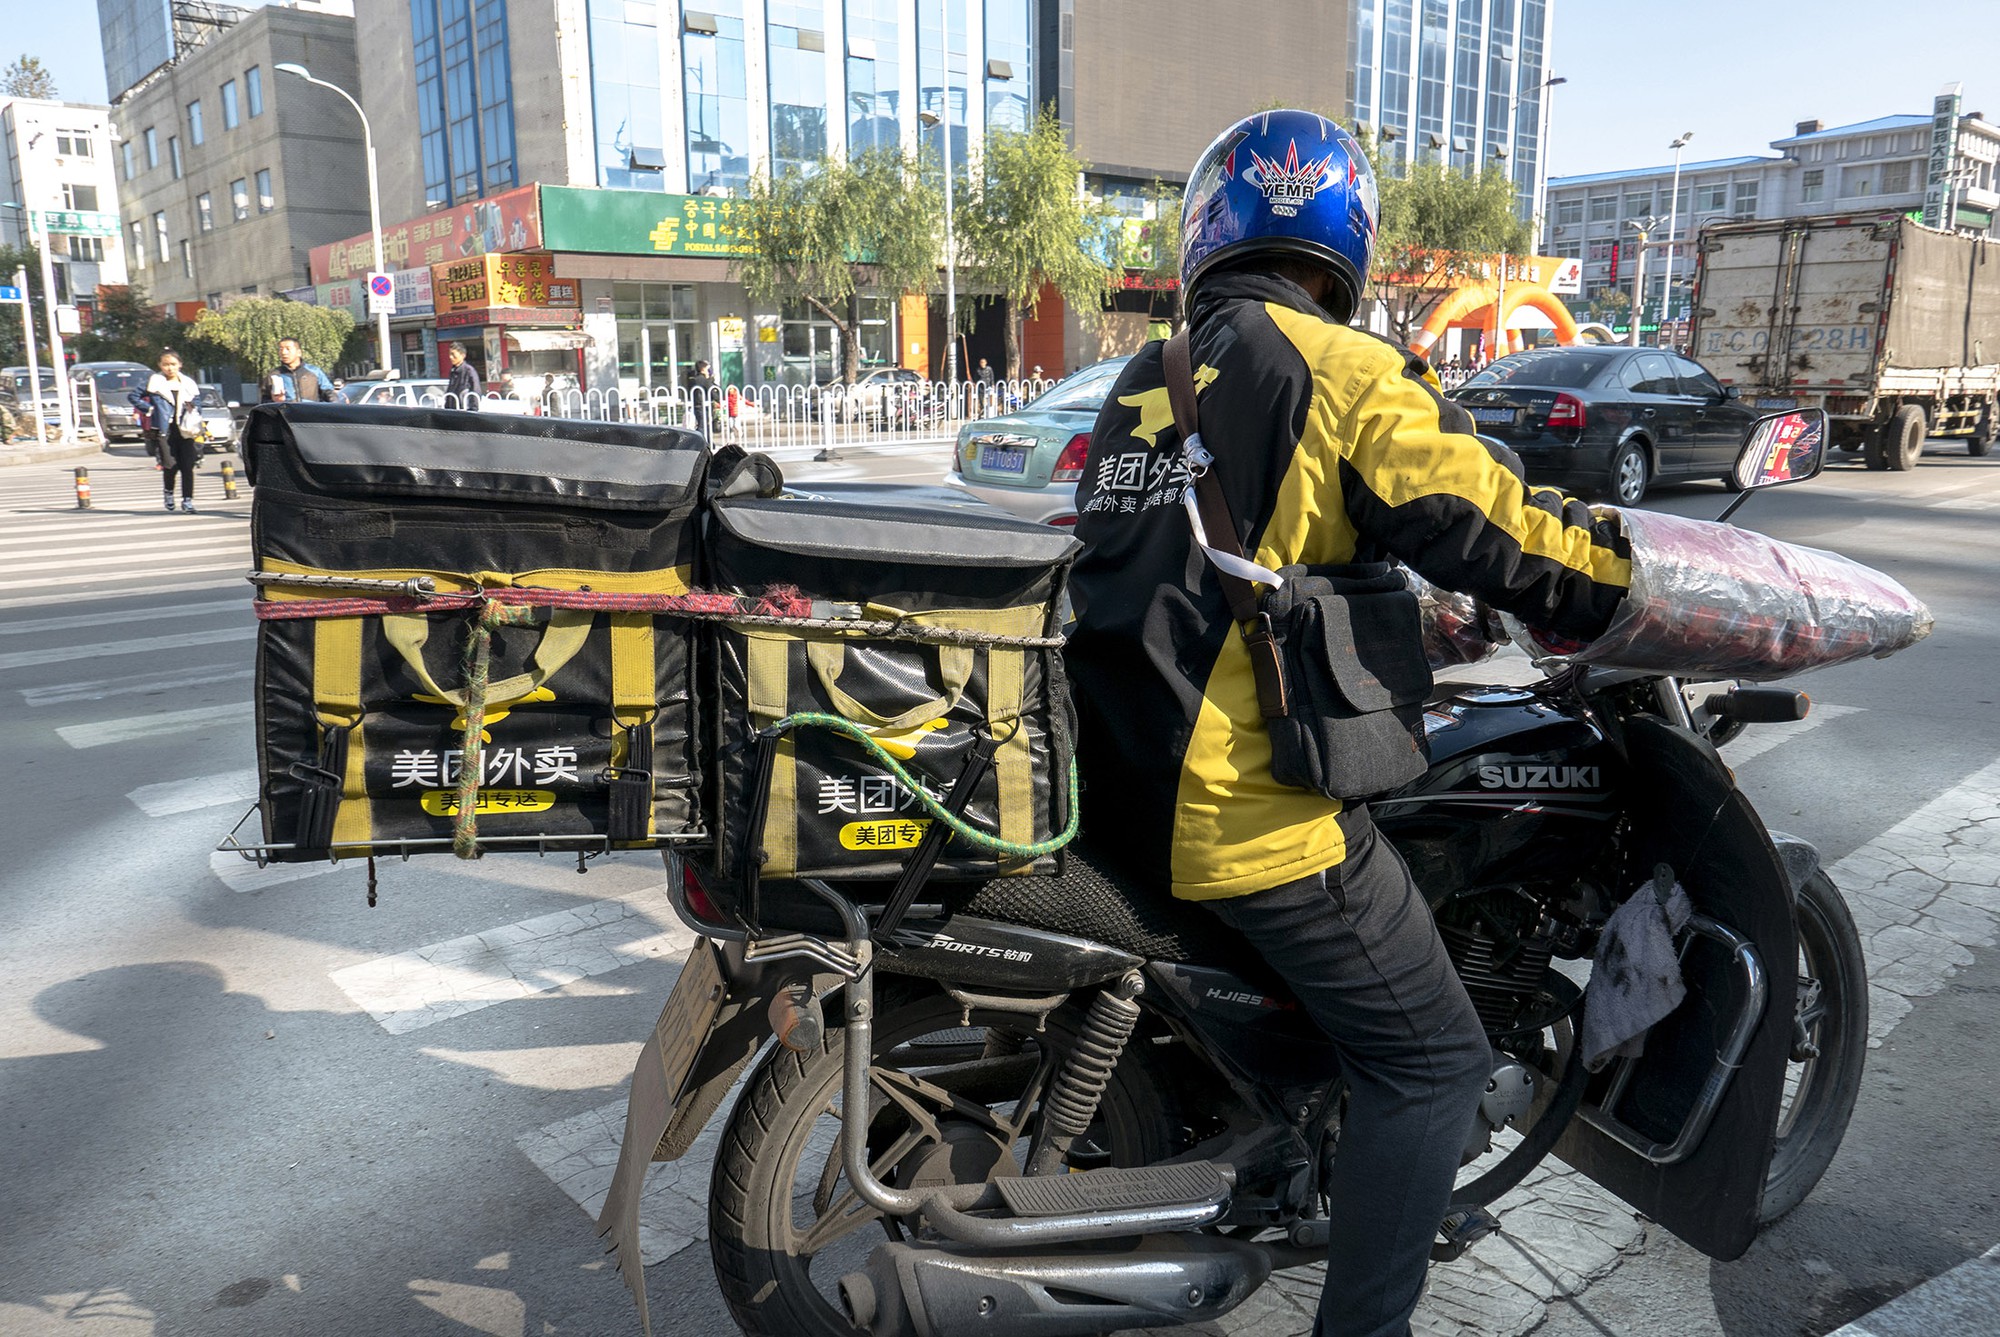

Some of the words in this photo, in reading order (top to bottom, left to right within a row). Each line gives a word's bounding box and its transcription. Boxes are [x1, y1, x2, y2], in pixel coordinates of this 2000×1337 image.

[1261, 183, 1315, 199] YEMA
[391, 746, 579, 789] 美团外卖
[1479, 765, 1600, 788] SUZUKI
[818, 774, 958, 815] 美团外
